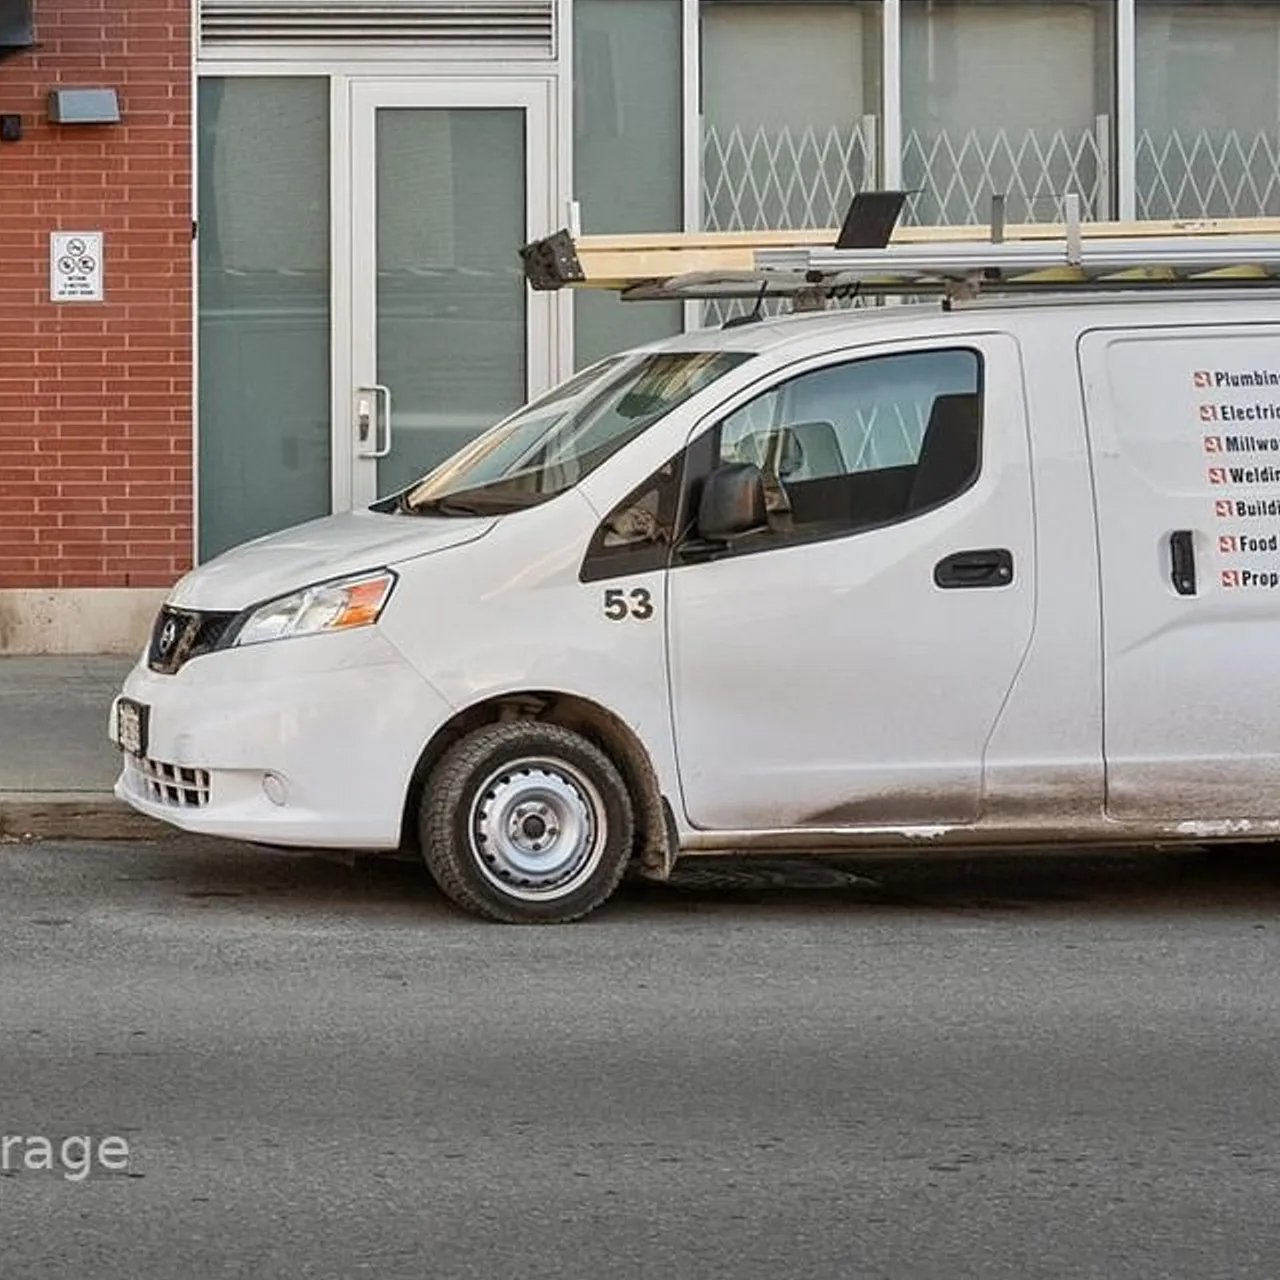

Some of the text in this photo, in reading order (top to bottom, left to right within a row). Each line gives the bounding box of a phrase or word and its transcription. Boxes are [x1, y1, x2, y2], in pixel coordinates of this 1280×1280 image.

[1214, 370, 1280, 387] Plumbin
[1225, 435, 1280, 452] Millwo
[1240, 535, 1278, 552] Food
[604, 587, 654, 621] 53
